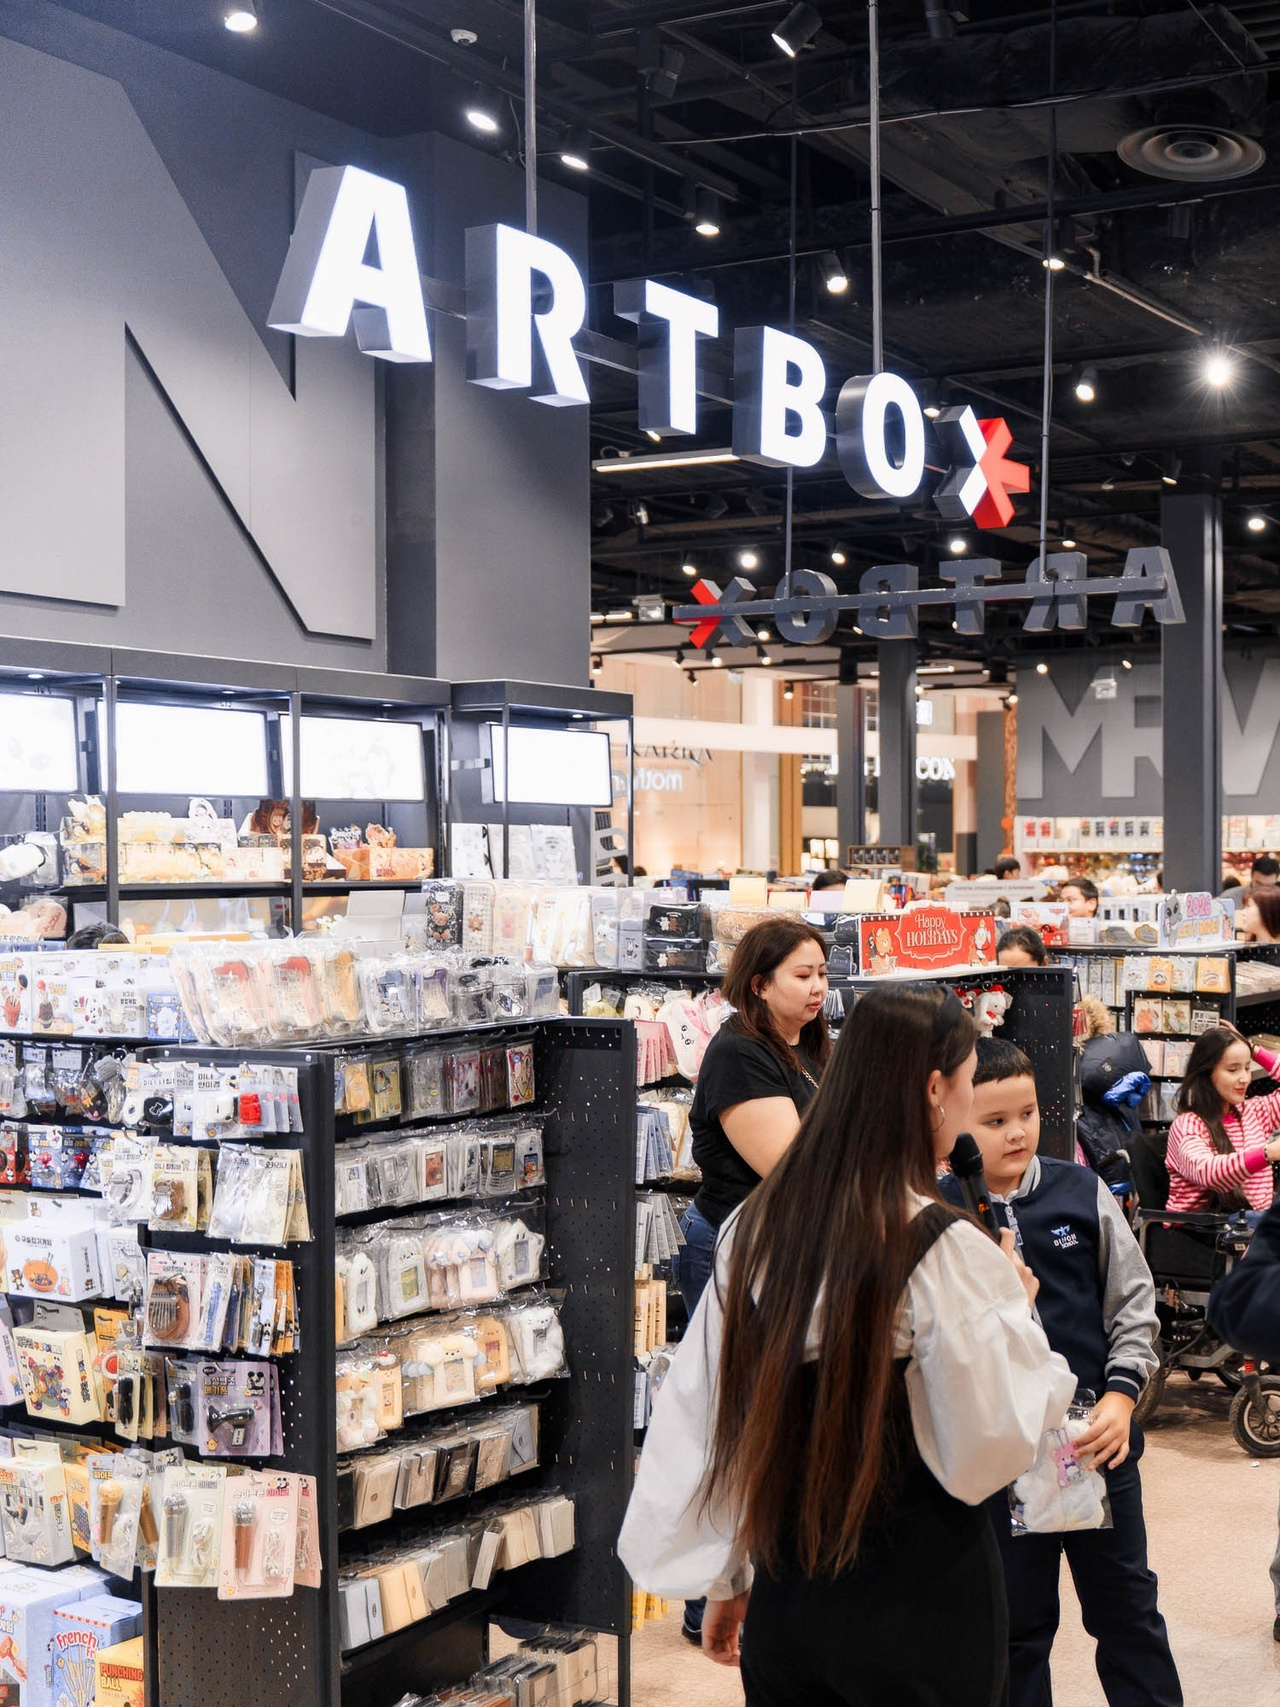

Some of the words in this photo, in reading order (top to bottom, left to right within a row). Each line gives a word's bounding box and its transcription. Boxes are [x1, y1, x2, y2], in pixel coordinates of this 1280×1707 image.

[268, 165, 1030, 529] ARTBOX
[1187, 894, 1212, 917] 2026
[915, 913, 946, 933] Happy
[906, 928, 958, 947] HOLIDAYS
[56, 1631, 98, 1650] French
[100, 1663, 144, 1682] PUNCHING
[101, 1676, 122, 1692] BALL
